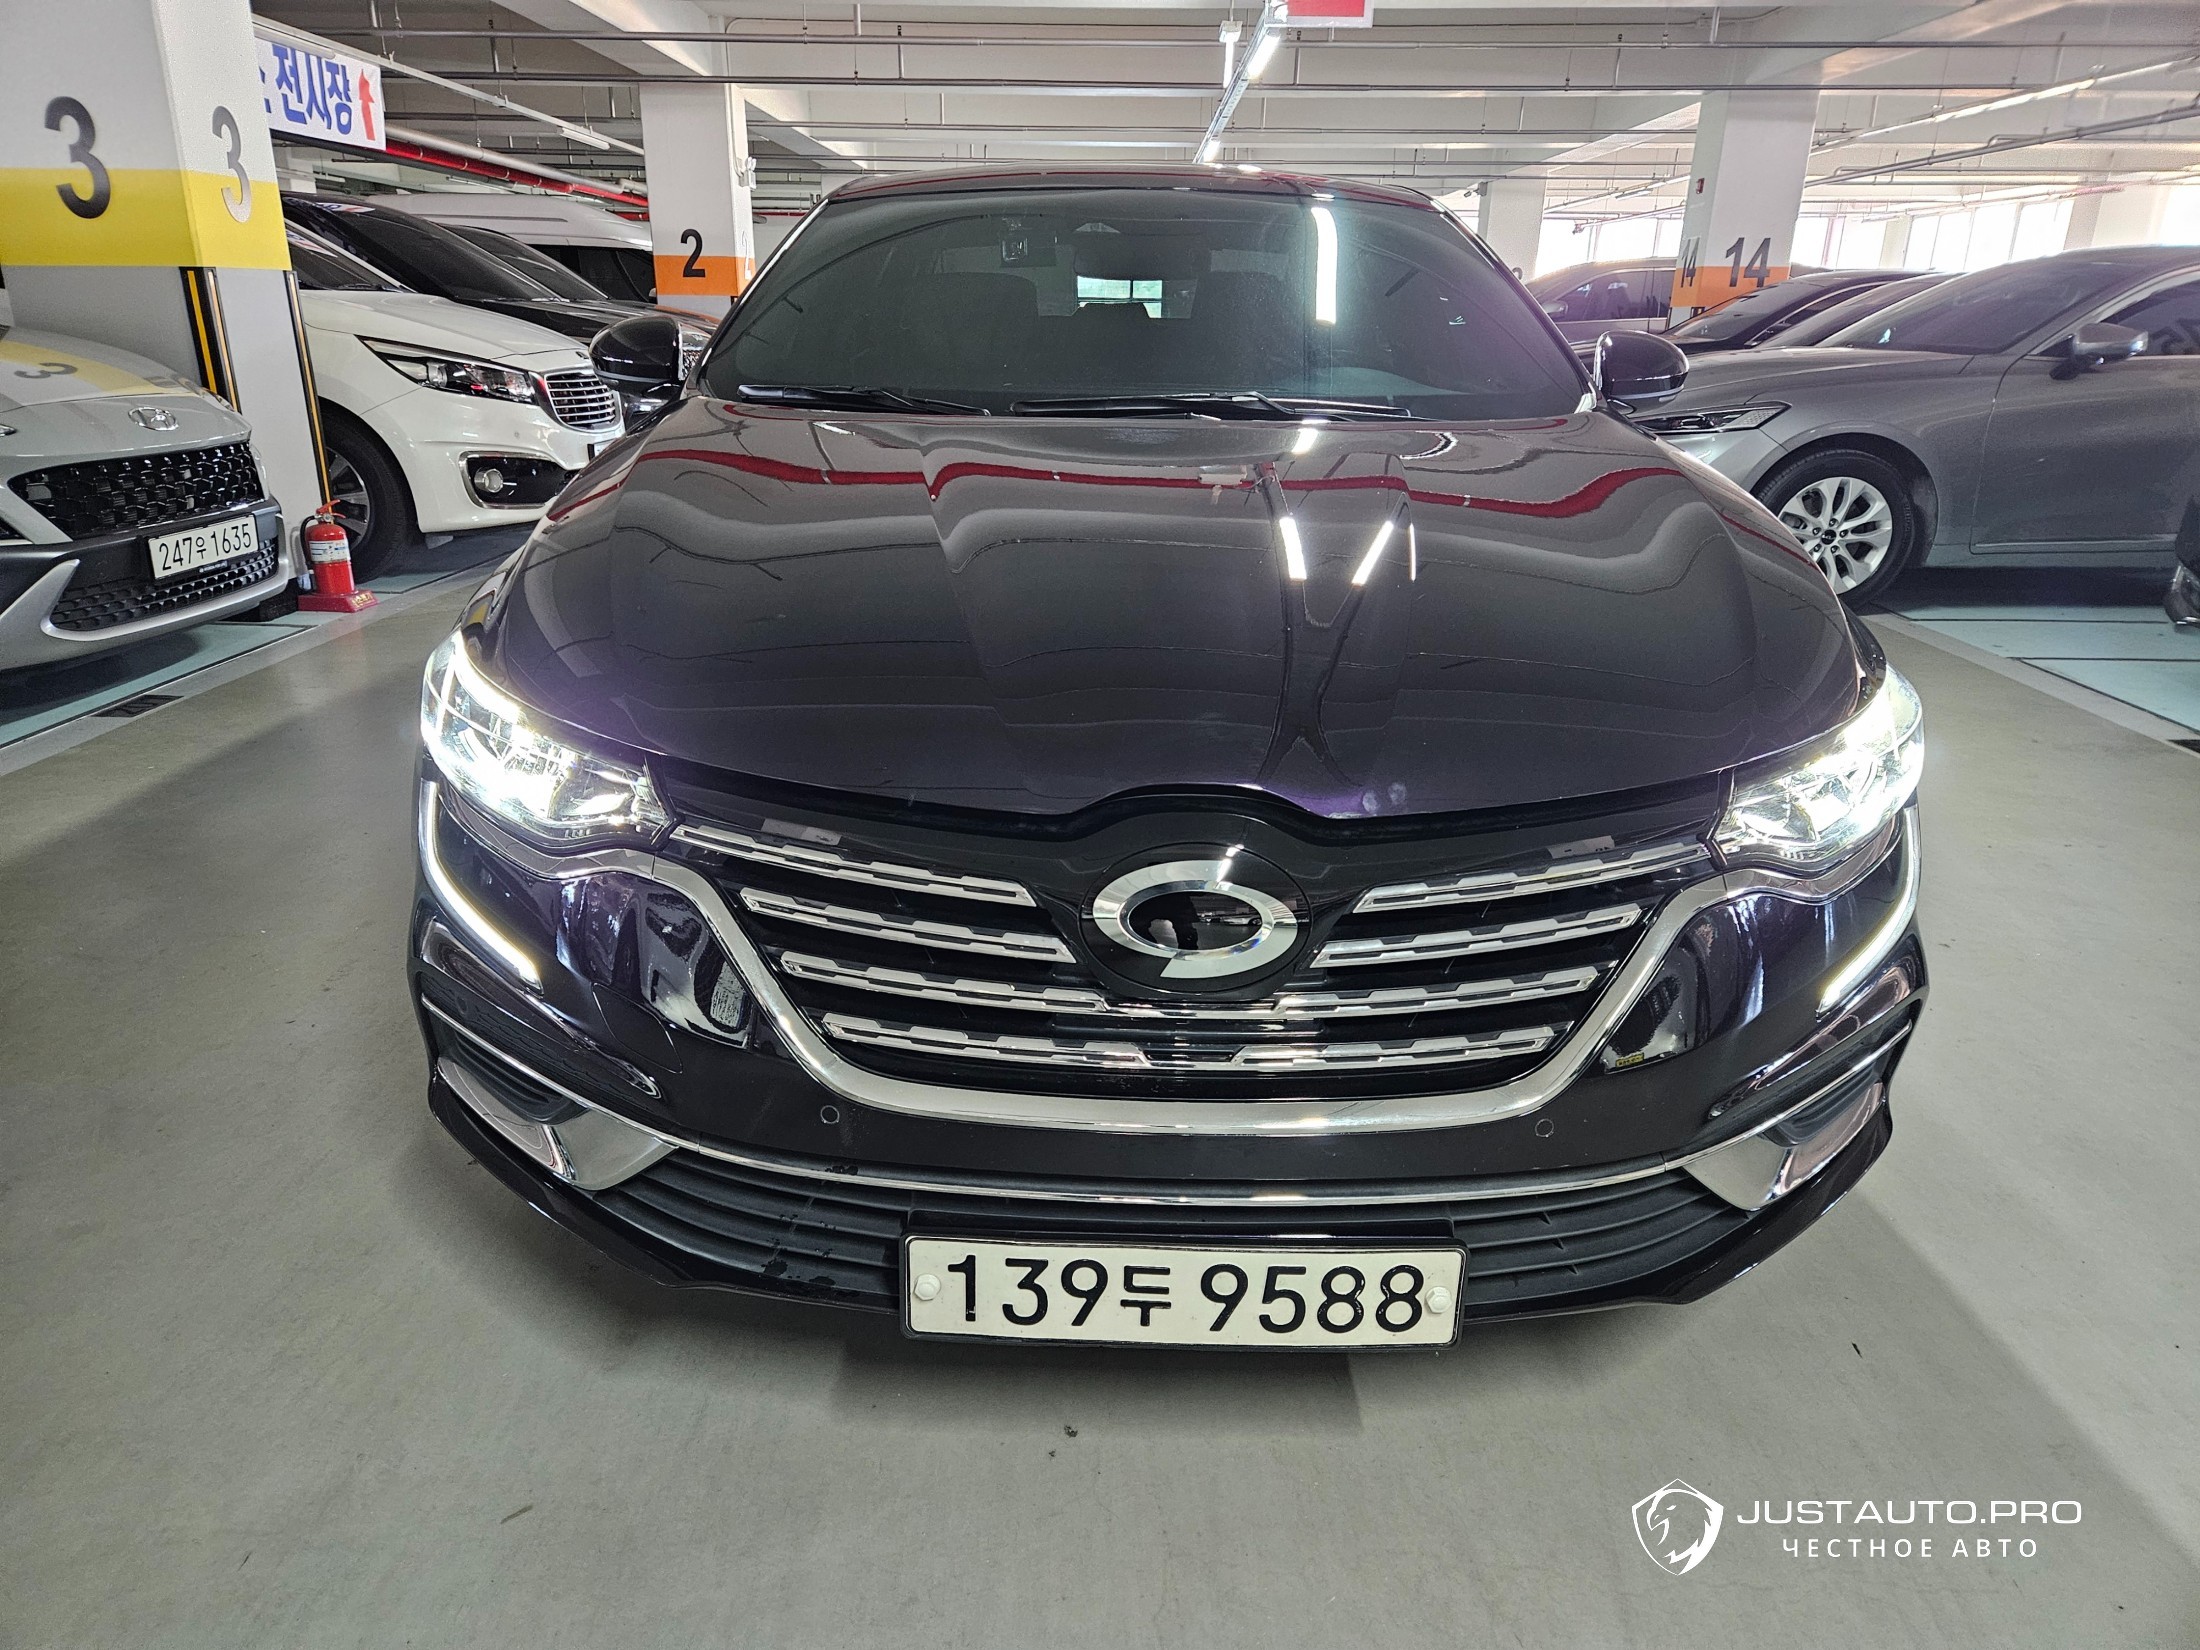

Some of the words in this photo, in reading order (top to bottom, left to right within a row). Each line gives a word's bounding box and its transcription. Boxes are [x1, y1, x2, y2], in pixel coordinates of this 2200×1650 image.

[271, 43, 353, 135] 전시장
[45, 95, 112, 220] 3
[212, 105, 253, 224] 3
[680, 228, 706, 278] 2
[1680, 237, 1700, 288] 14
[1725, 236, 1772, 288] 14
[158, 536, 207, 571] 247우
[210, 523, 252, 556] 1635
[947, 1254, 1172, 1328] 139두
[1199, 1263, 1426, 1334] 9588
